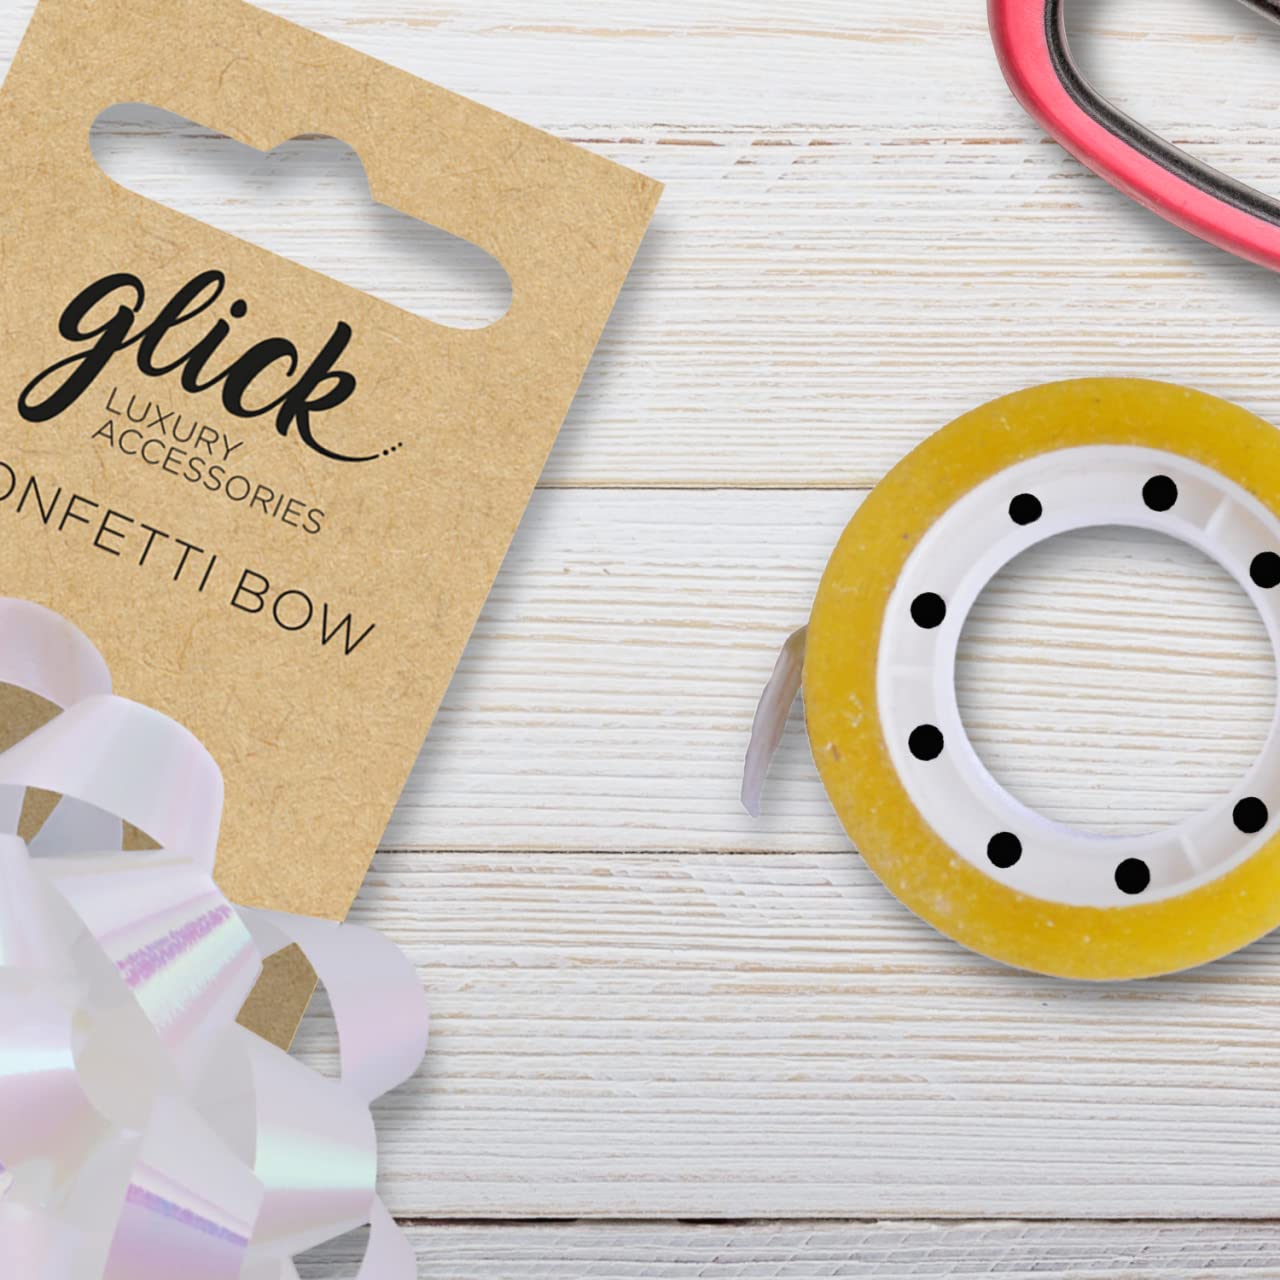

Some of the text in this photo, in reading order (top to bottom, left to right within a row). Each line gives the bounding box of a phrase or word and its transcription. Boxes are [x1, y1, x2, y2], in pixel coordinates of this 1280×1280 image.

[105, 386, 244, 462] LUXURY
[91, 419, 326, 535] ACCESSORIES
[230, 568, 376, 656] BOW
